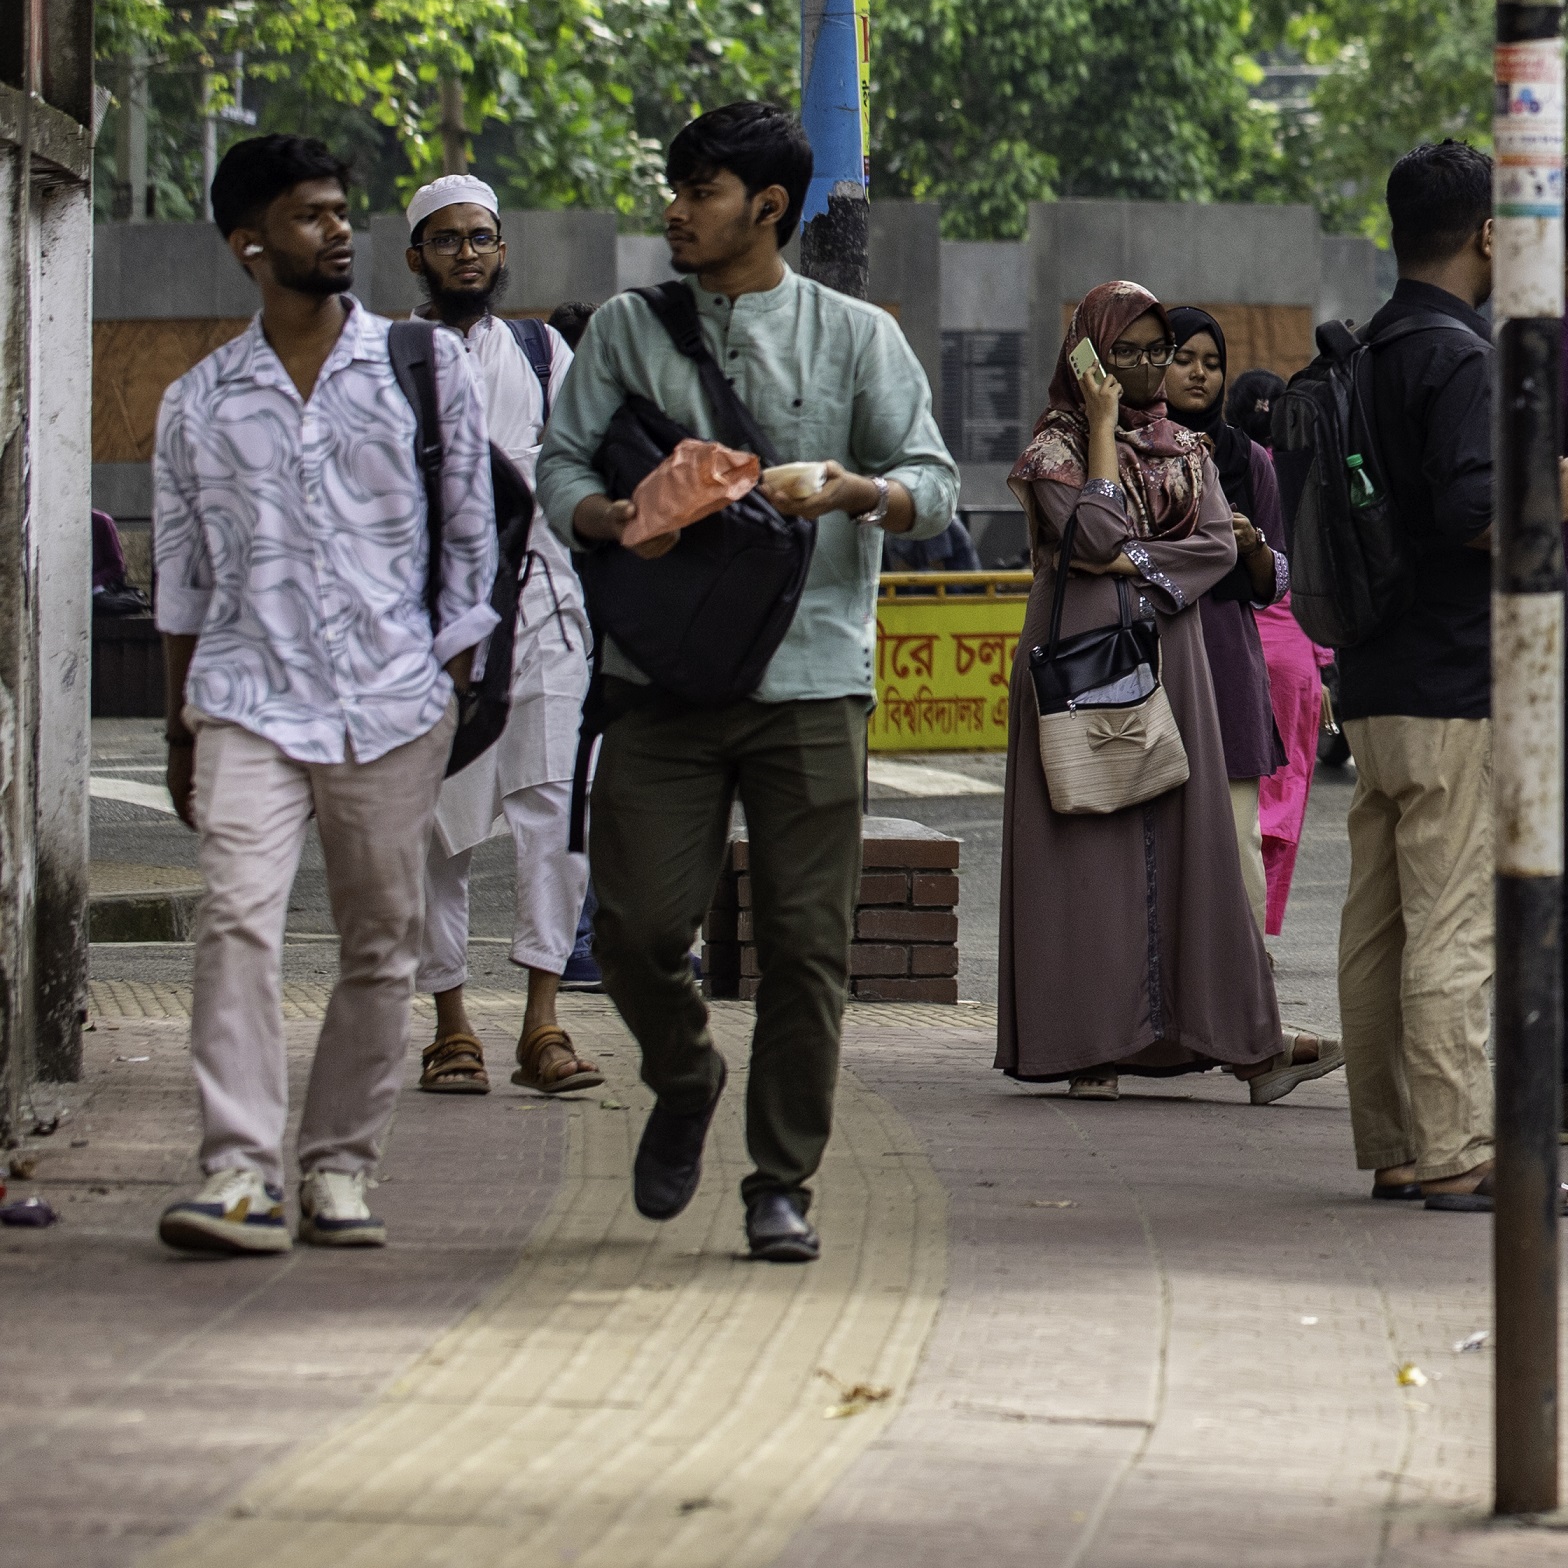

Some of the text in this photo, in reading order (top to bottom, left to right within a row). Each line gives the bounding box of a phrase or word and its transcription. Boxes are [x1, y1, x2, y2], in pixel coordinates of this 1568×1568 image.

[877, 618, 1022, 689] ীরে চলু
[883, 685, 987, 736] বিশ্ববিদ্যালয়
